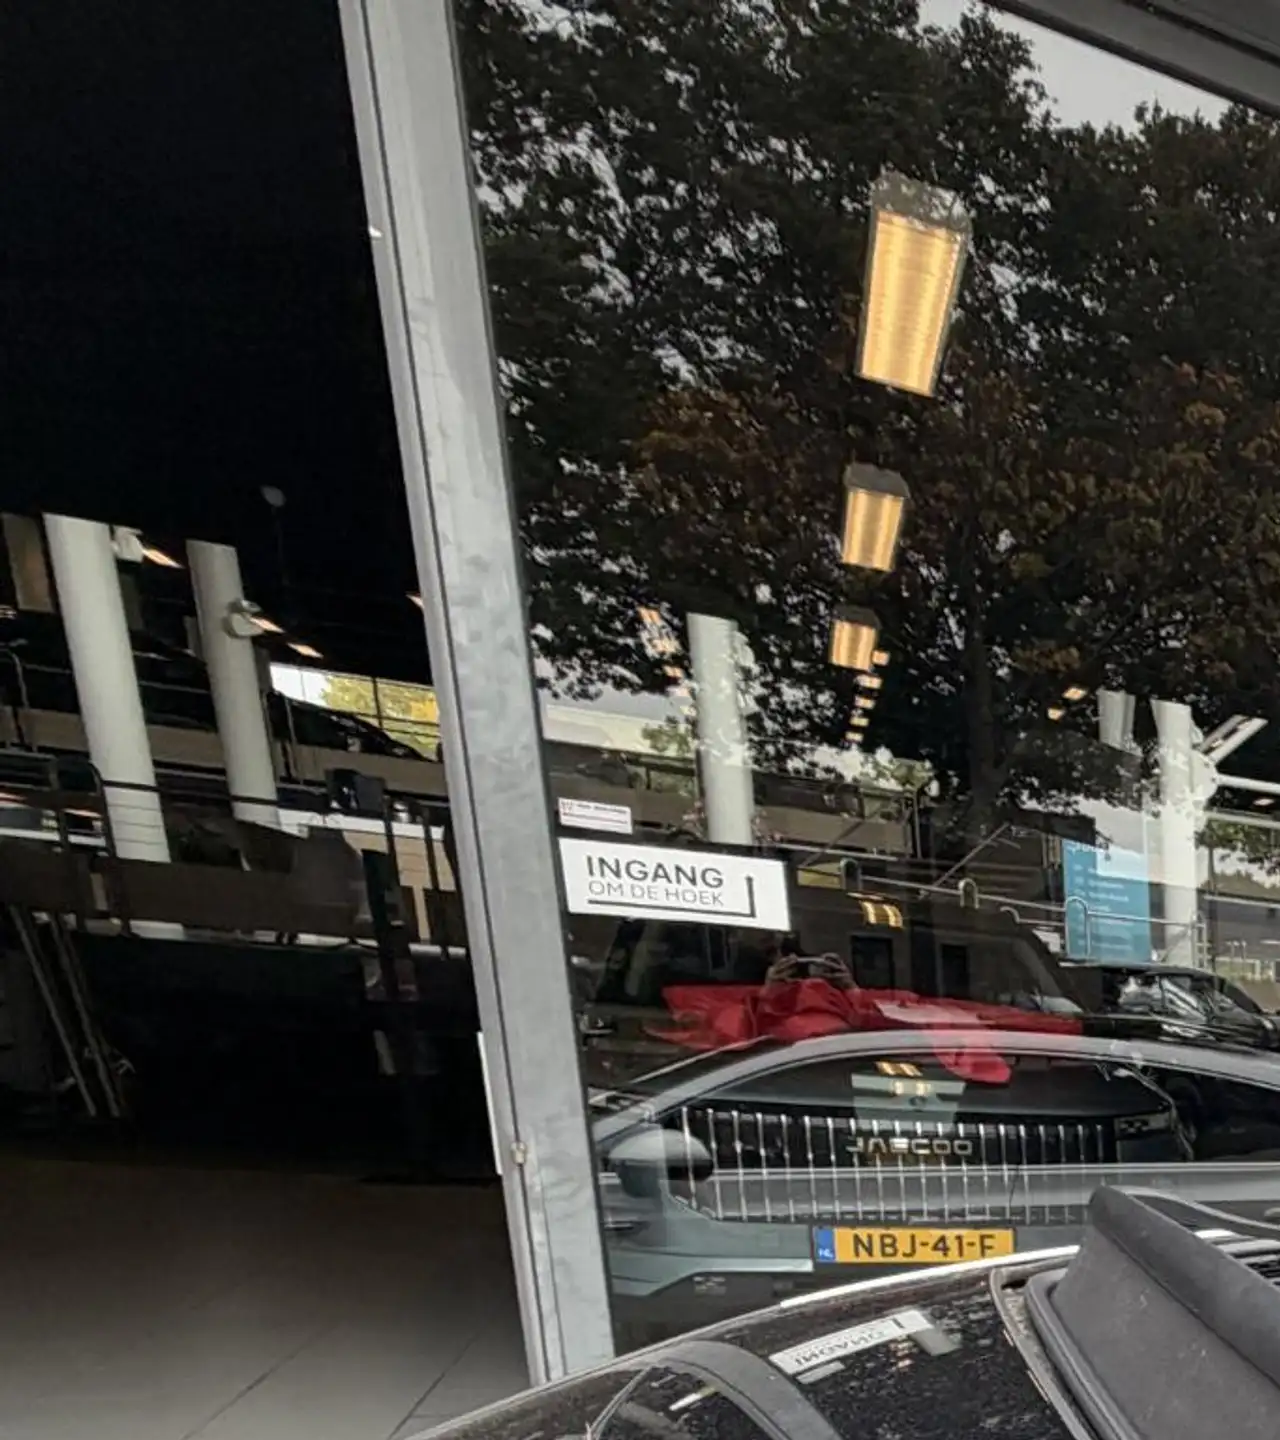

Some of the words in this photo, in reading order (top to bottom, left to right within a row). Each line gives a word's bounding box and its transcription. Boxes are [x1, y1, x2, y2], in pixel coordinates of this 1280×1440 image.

[586, 855, 724, 889] INGANG
[588, 880, 624, 897] OM
[630, 884, 658, 901] DE
[664, 887, 724, 906] HOEK
[845, 1136, 973, 1156] JAECOO
[853, 1233, 997, 1258] NBJ-41-F
